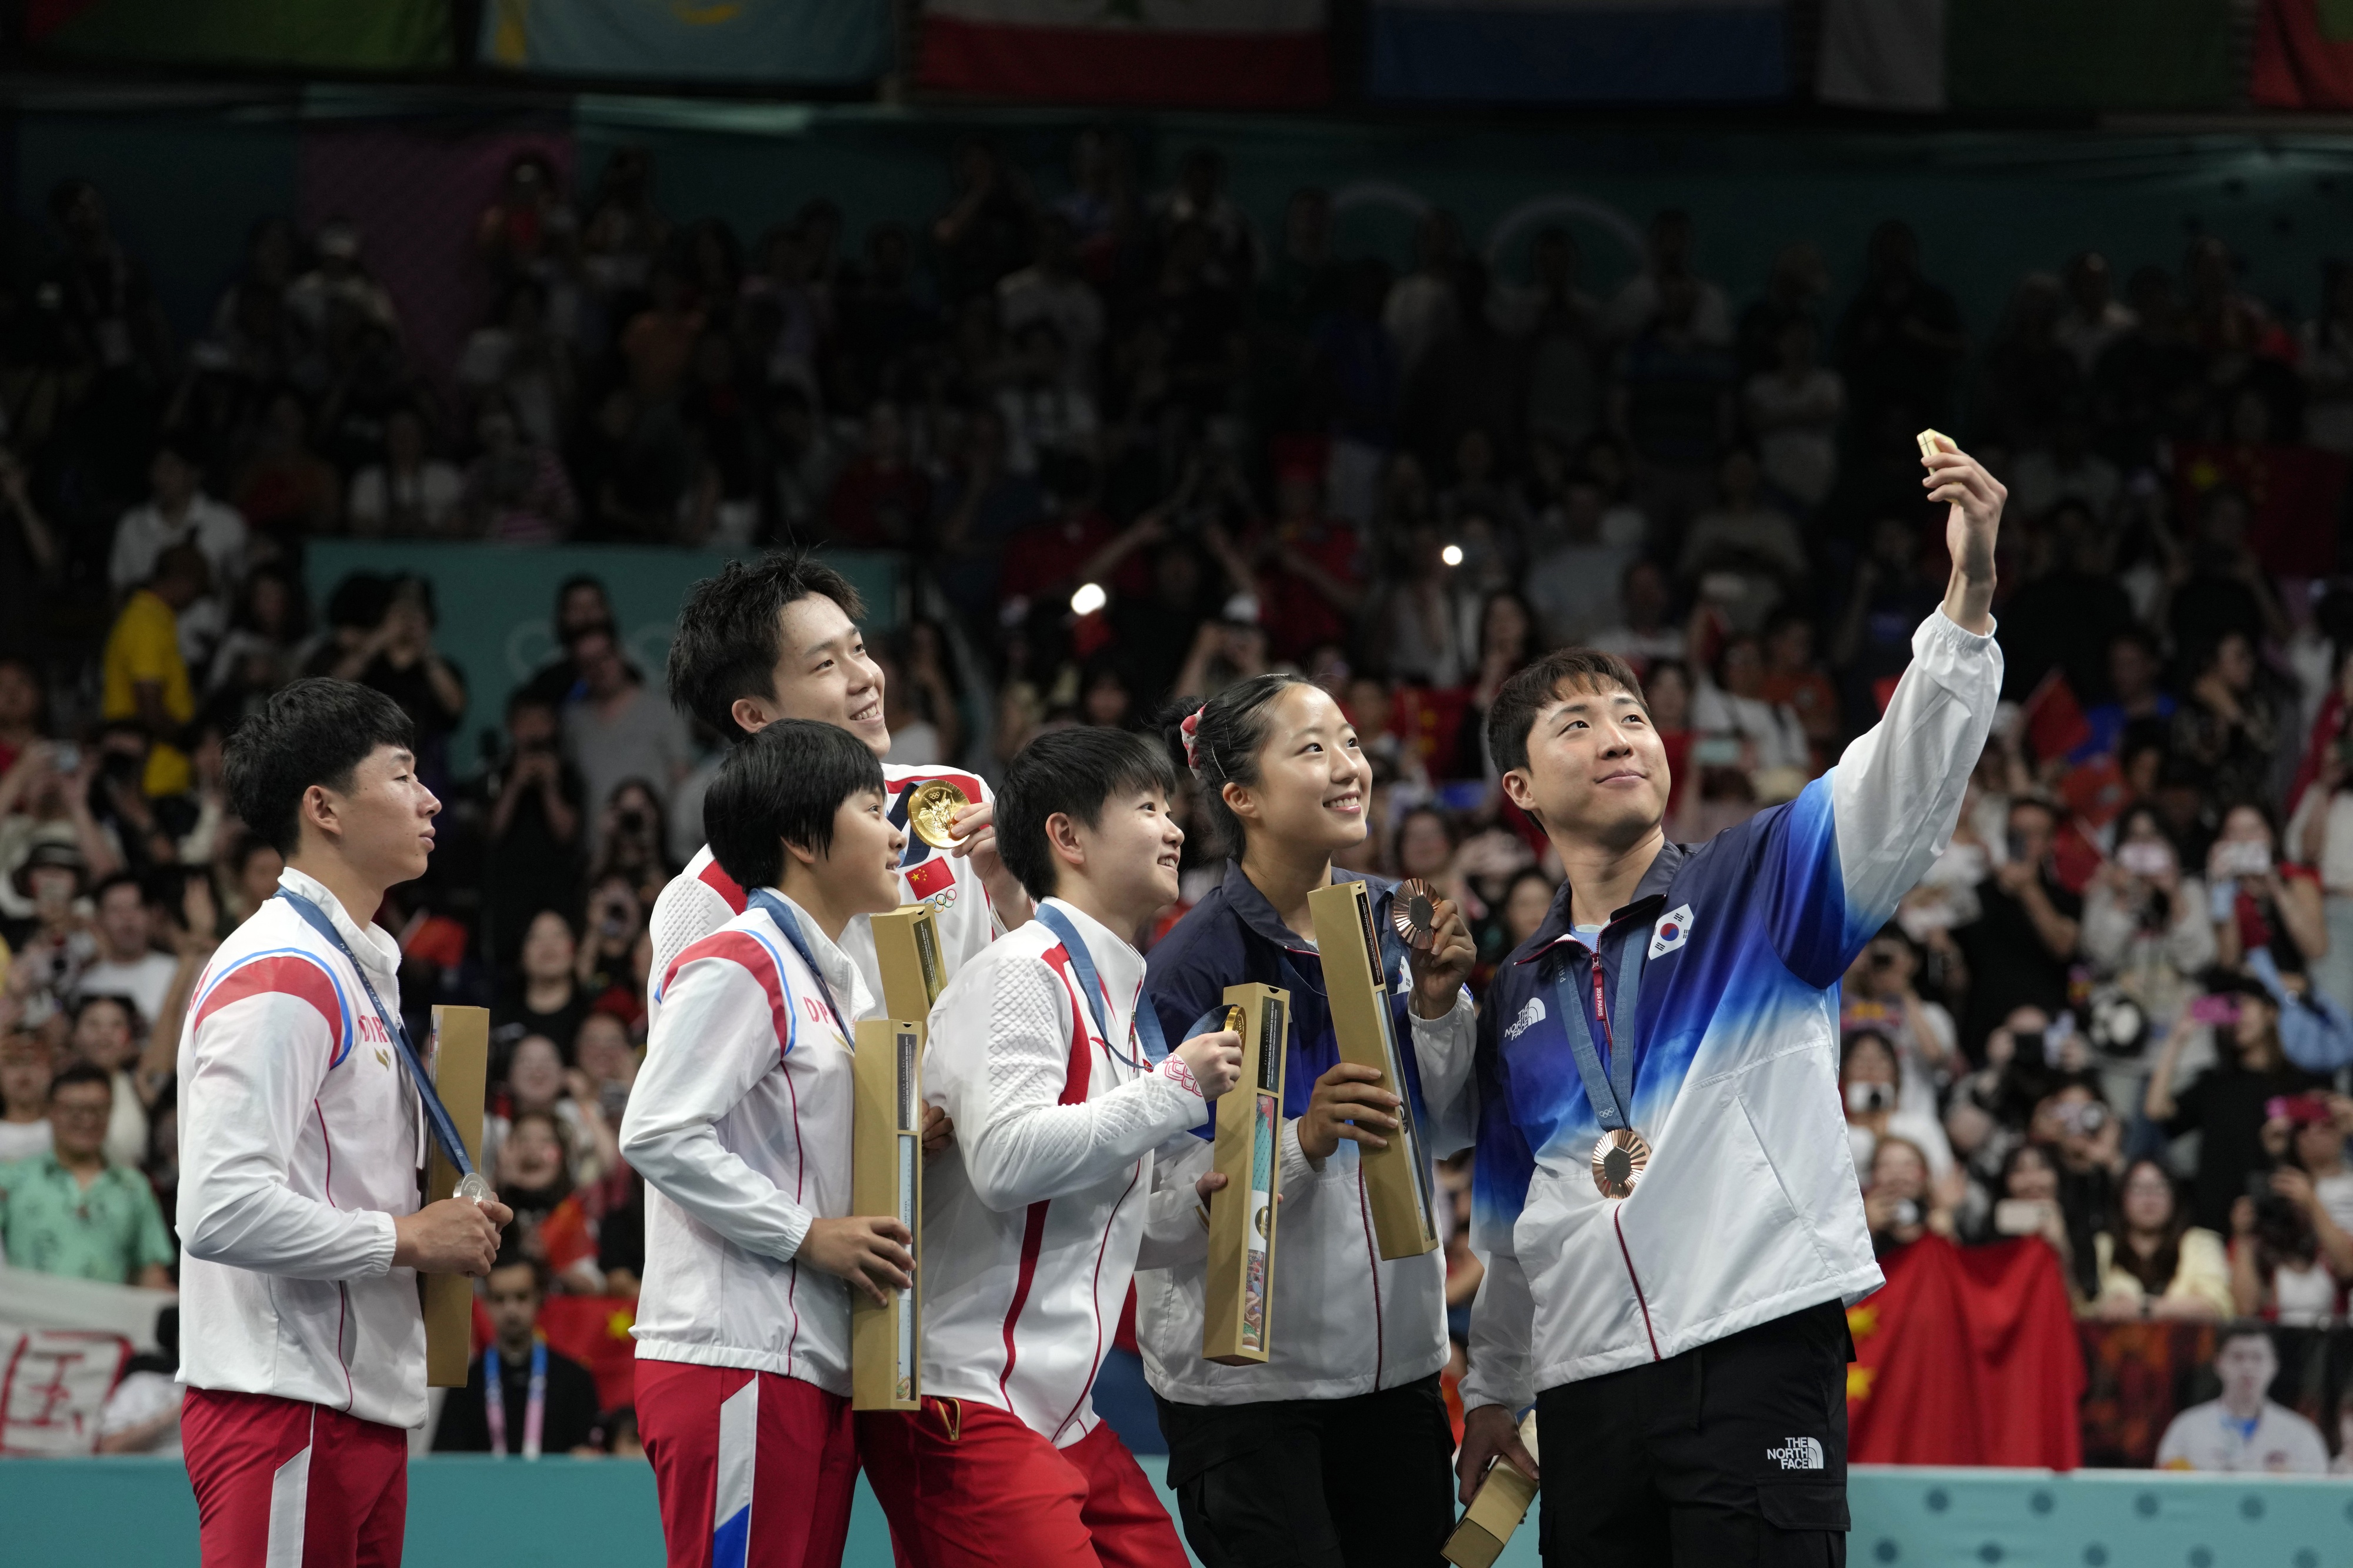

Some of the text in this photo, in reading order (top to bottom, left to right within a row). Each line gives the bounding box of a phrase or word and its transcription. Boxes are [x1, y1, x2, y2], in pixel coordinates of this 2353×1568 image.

[1518, 1001, 1529, 1020] THE
[1505, 1011, 1529, 1037] NORTH
[1511, 1022, 1528, 1041] FACE
[1785, 1437, 1808, 1448] THE
[1767, 1447, 1808, 1460] NORTH
[1781, 1458, 1808, 1470] FACE
